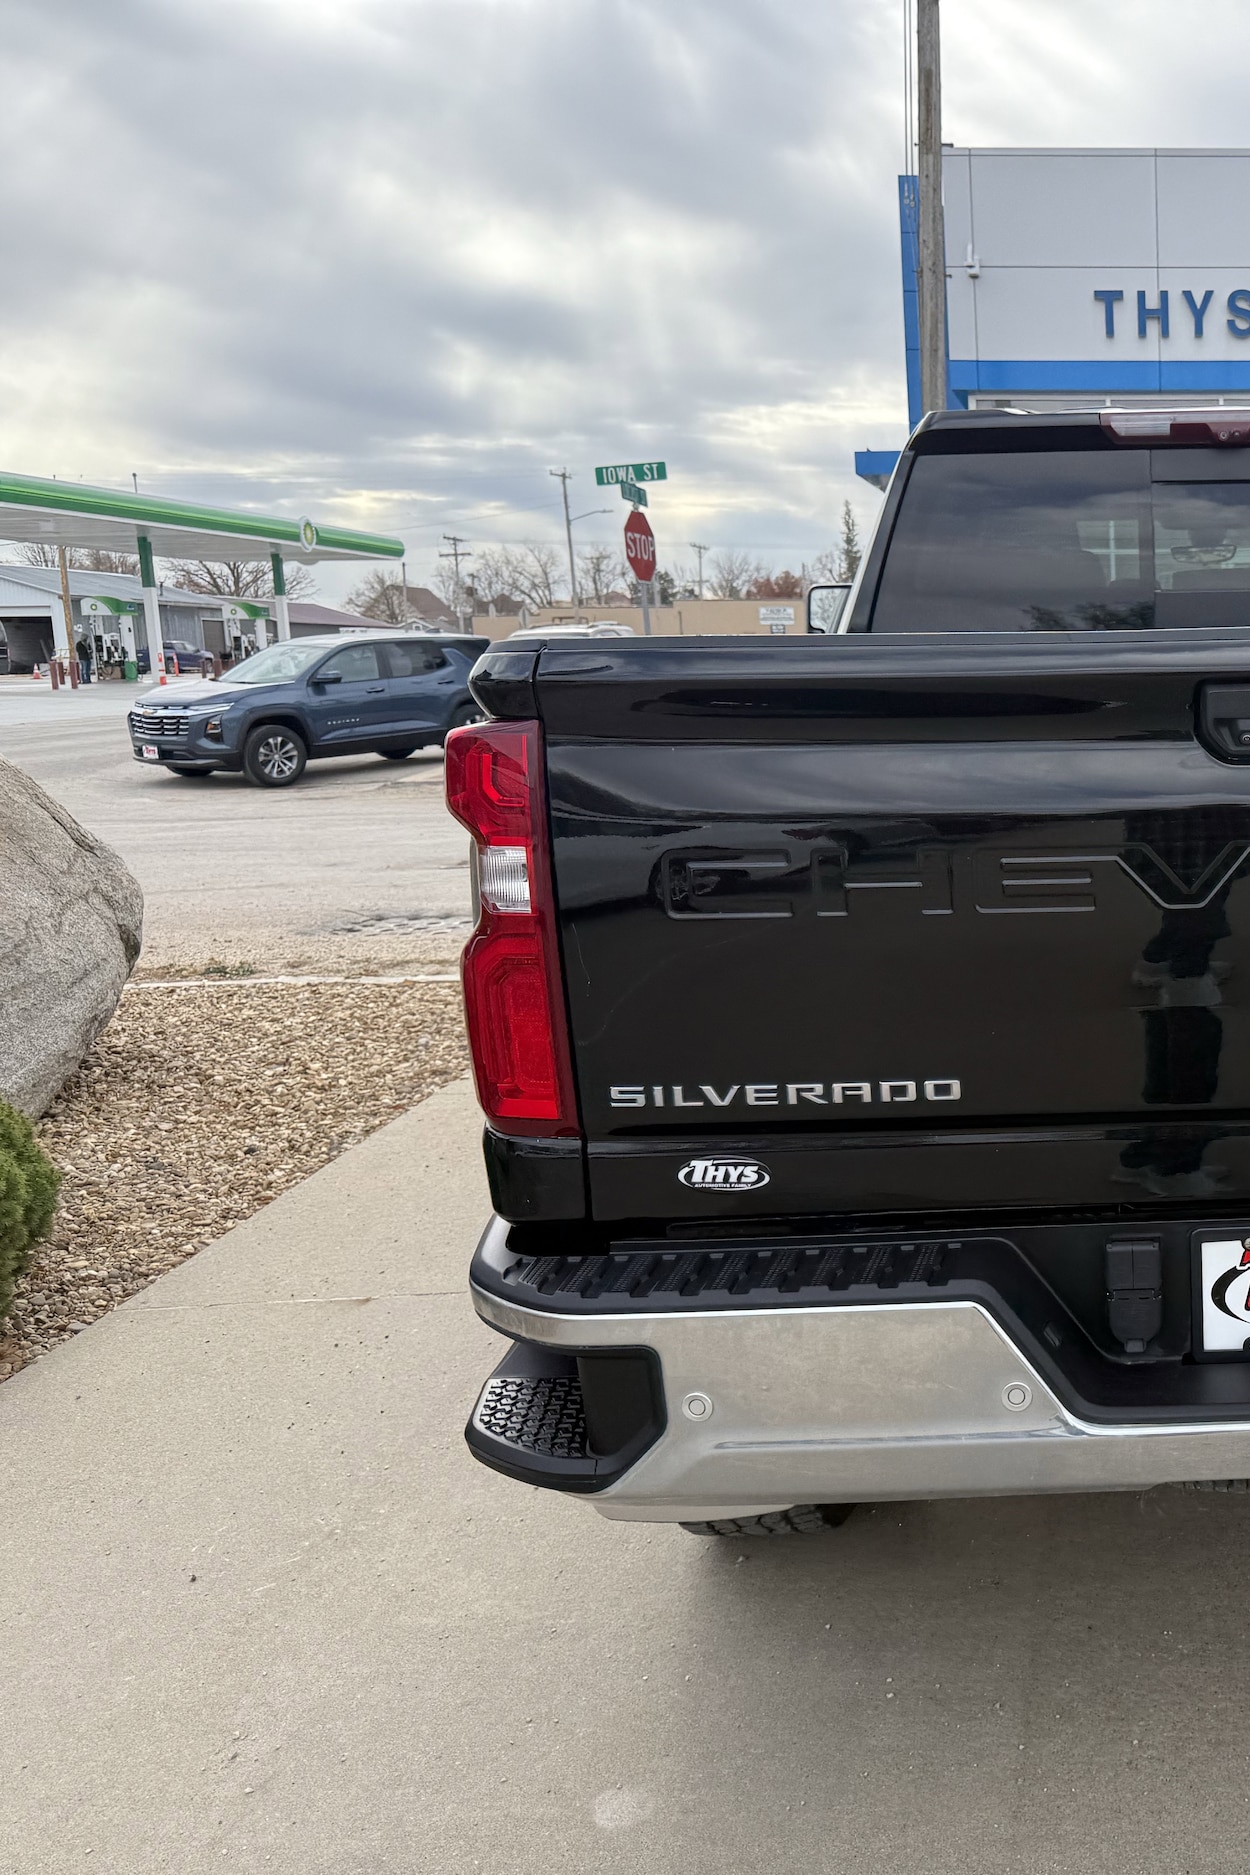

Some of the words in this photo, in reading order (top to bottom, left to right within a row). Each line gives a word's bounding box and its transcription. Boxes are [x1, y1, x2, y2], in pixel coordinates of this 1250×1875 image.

[602, 466, 636, 484] IOWA
[643, 463, 658, 481] ST
[626, 531, 655, 562] STOP
[610, 1079, 961, 1108] SILVERADO
[689, 1159, 760, 1183] THYS
